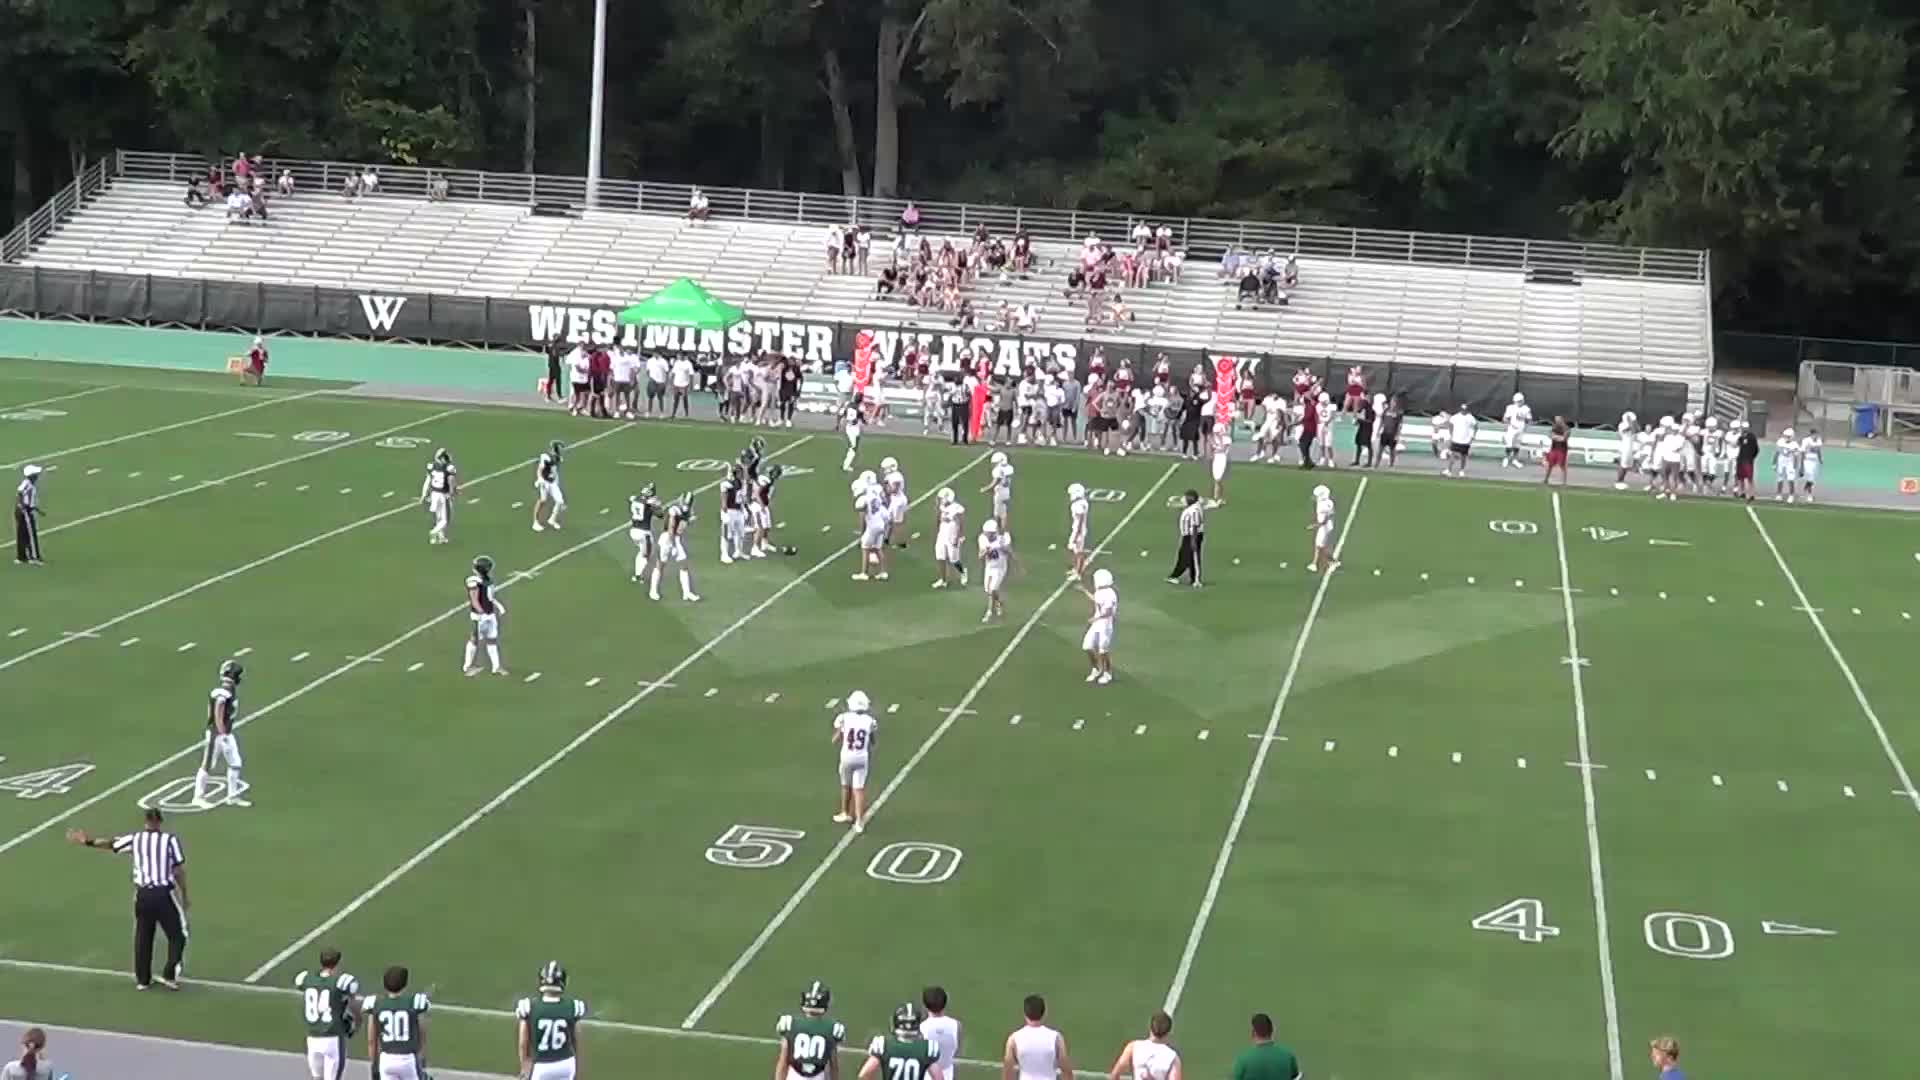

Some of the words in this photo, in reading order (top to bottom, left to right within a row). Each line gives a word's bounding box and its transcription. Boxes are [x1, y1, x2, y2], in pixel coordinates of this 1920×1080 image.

[358, 294, 407, 331] W
[528, 304, 833, 361] WESTMINSTER
[847, 727, 867, 752] 49
[304, 987, 333, 1023] 84
[379, 1010, 411, 1043] 30
[537, 1018, 569, 1051] 76
[888, 1056, 921, 1080] 70
